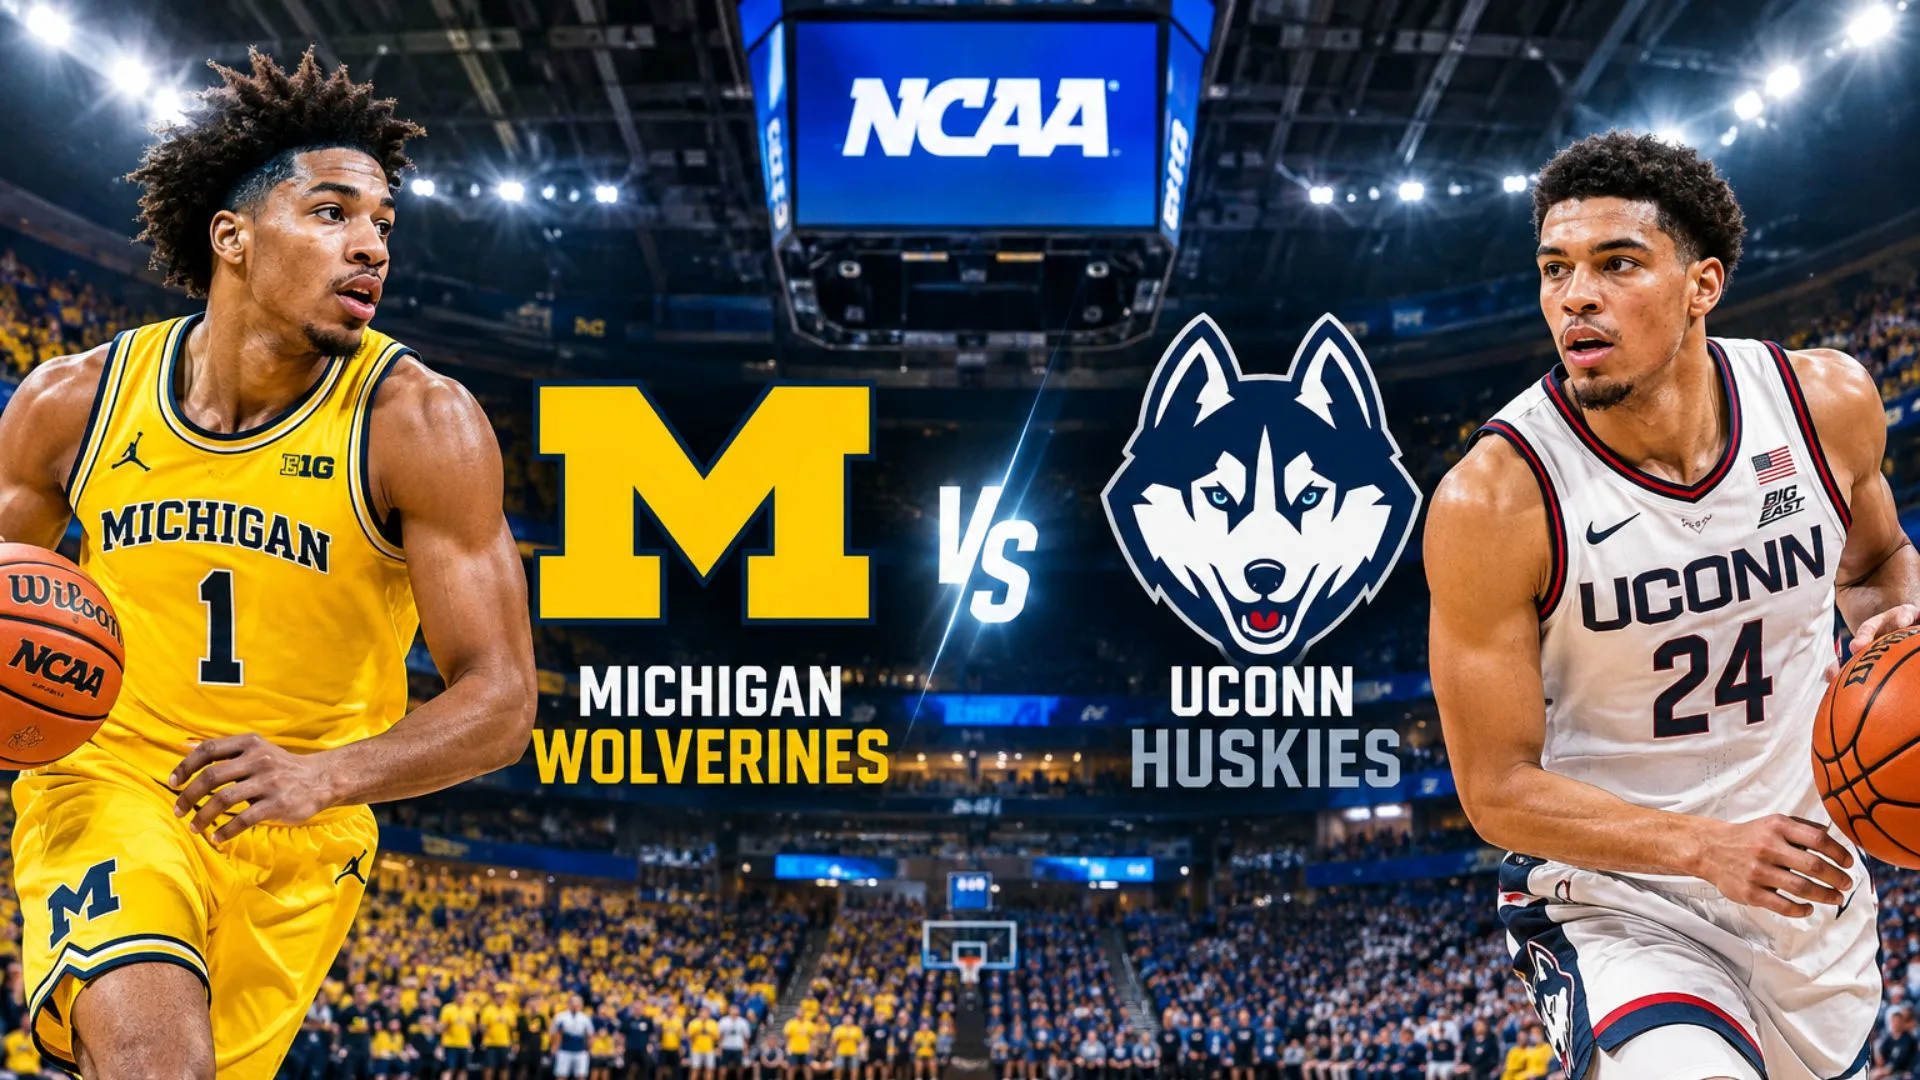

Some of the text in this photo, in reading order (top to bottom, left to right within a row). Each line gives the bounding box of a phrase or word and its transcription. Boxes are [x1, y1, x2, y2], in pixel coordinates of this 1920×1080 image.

[842, 78, 1110, 157] NCAA
[1759, 497, 1806, 522] EAST
[1762, 485, 1798, 509] BIG
[101, 500, 331, 575] MICHIGAN
[8, 574, 124, 648] Wilson
[1579, 525, 1826, 632] UCONN
[197, 569, 245, 687] 1
[8, 638, 105, 699] NCAA
[1653, 618, 1773, 739] 24
[47, 857, 121, 951] M
